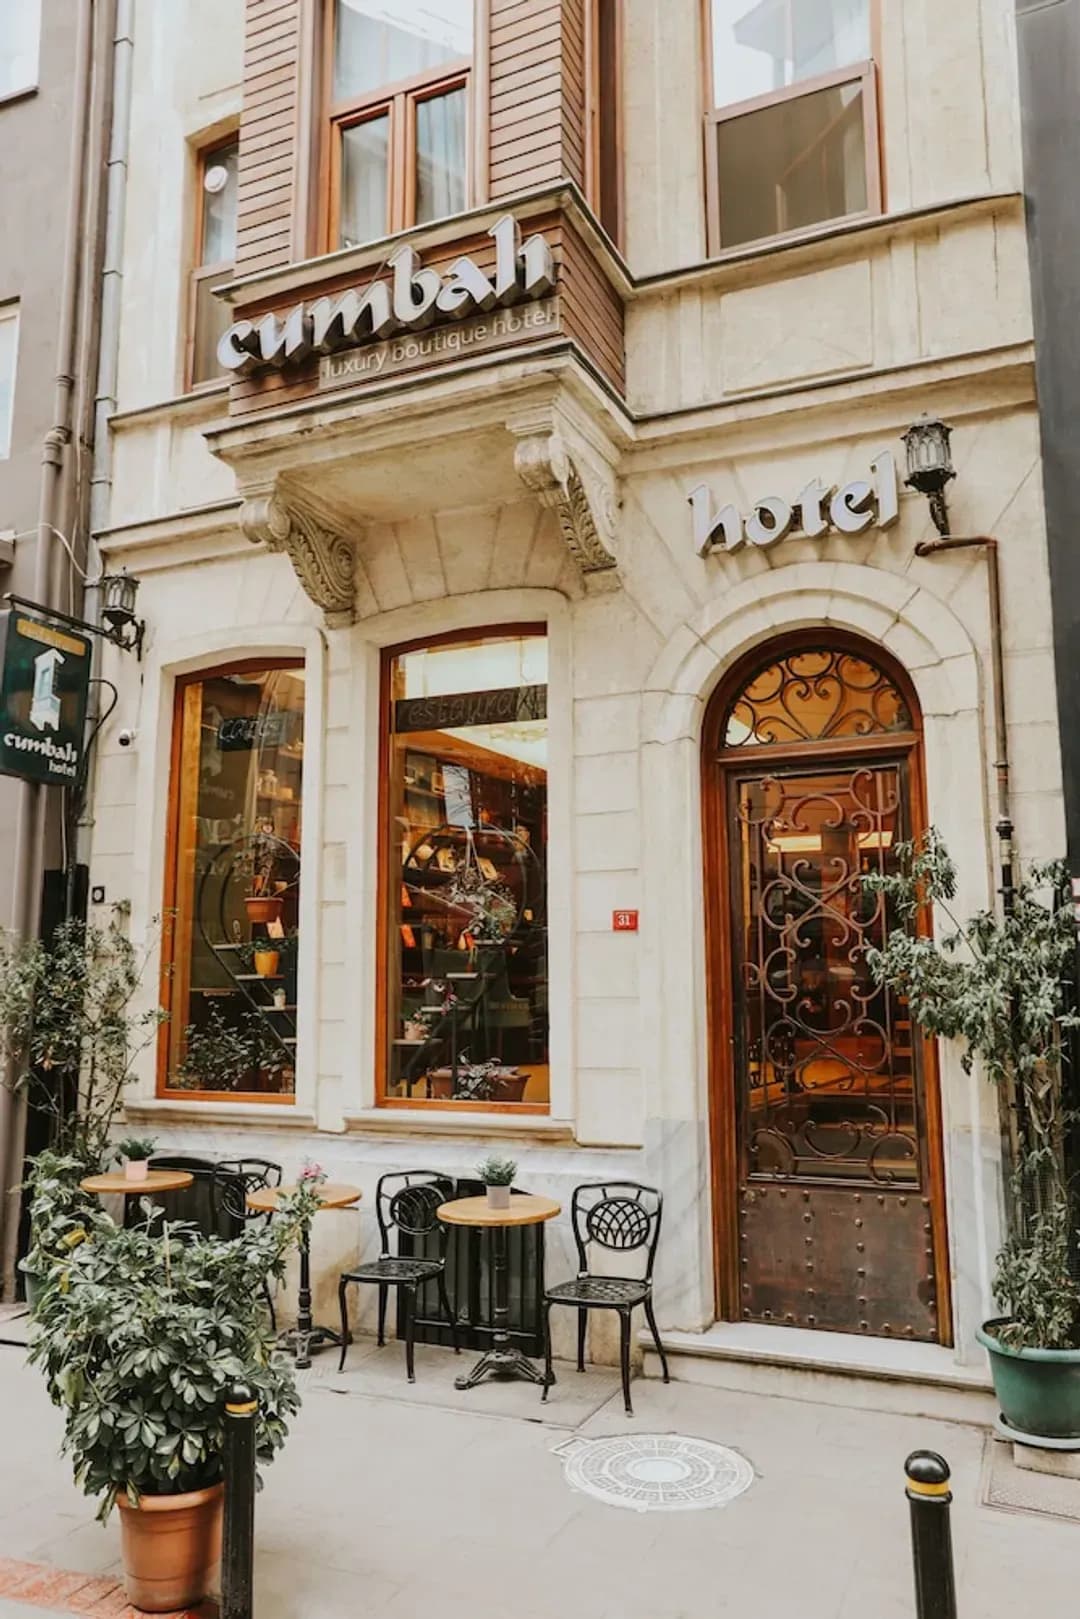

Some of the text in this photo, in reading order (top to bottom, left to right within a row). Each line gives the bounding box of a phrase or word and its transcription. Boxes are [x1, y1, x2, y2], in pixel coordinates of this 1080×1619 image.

[324, 303, 552, 379] luxury boutique hotel
[688, 450, 898, 559] hotel
[49, 760, 77, 778] hotel
[618, 914, 630, 926] 31
